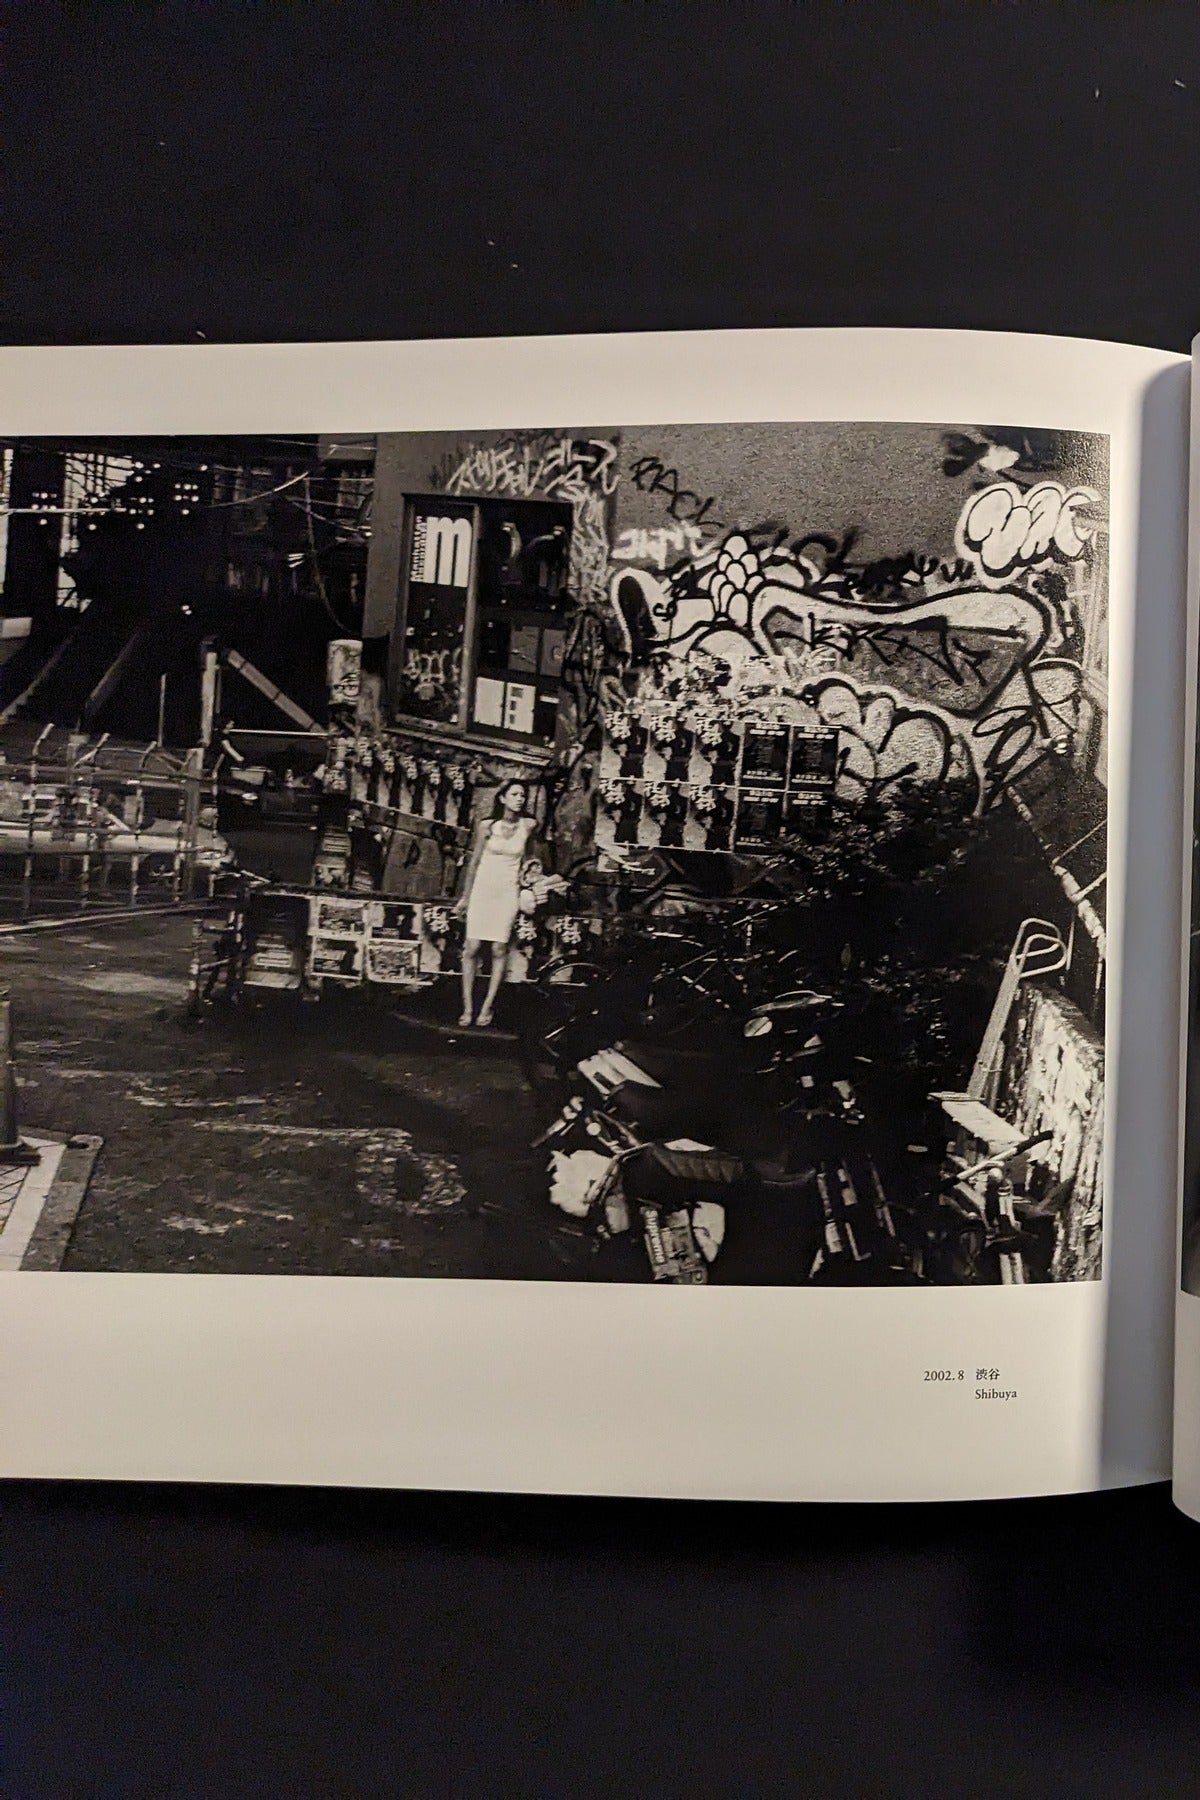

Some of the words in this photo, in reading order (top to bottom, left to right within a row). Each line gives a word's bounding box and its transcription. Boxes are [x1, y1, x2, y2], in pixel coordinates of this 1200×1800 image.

[644, 1210, 665, 1263] Supreme
[975, 1367, 1001, 1381] 渋谷
[974, 1388, 1018, 1401] Shibuya
